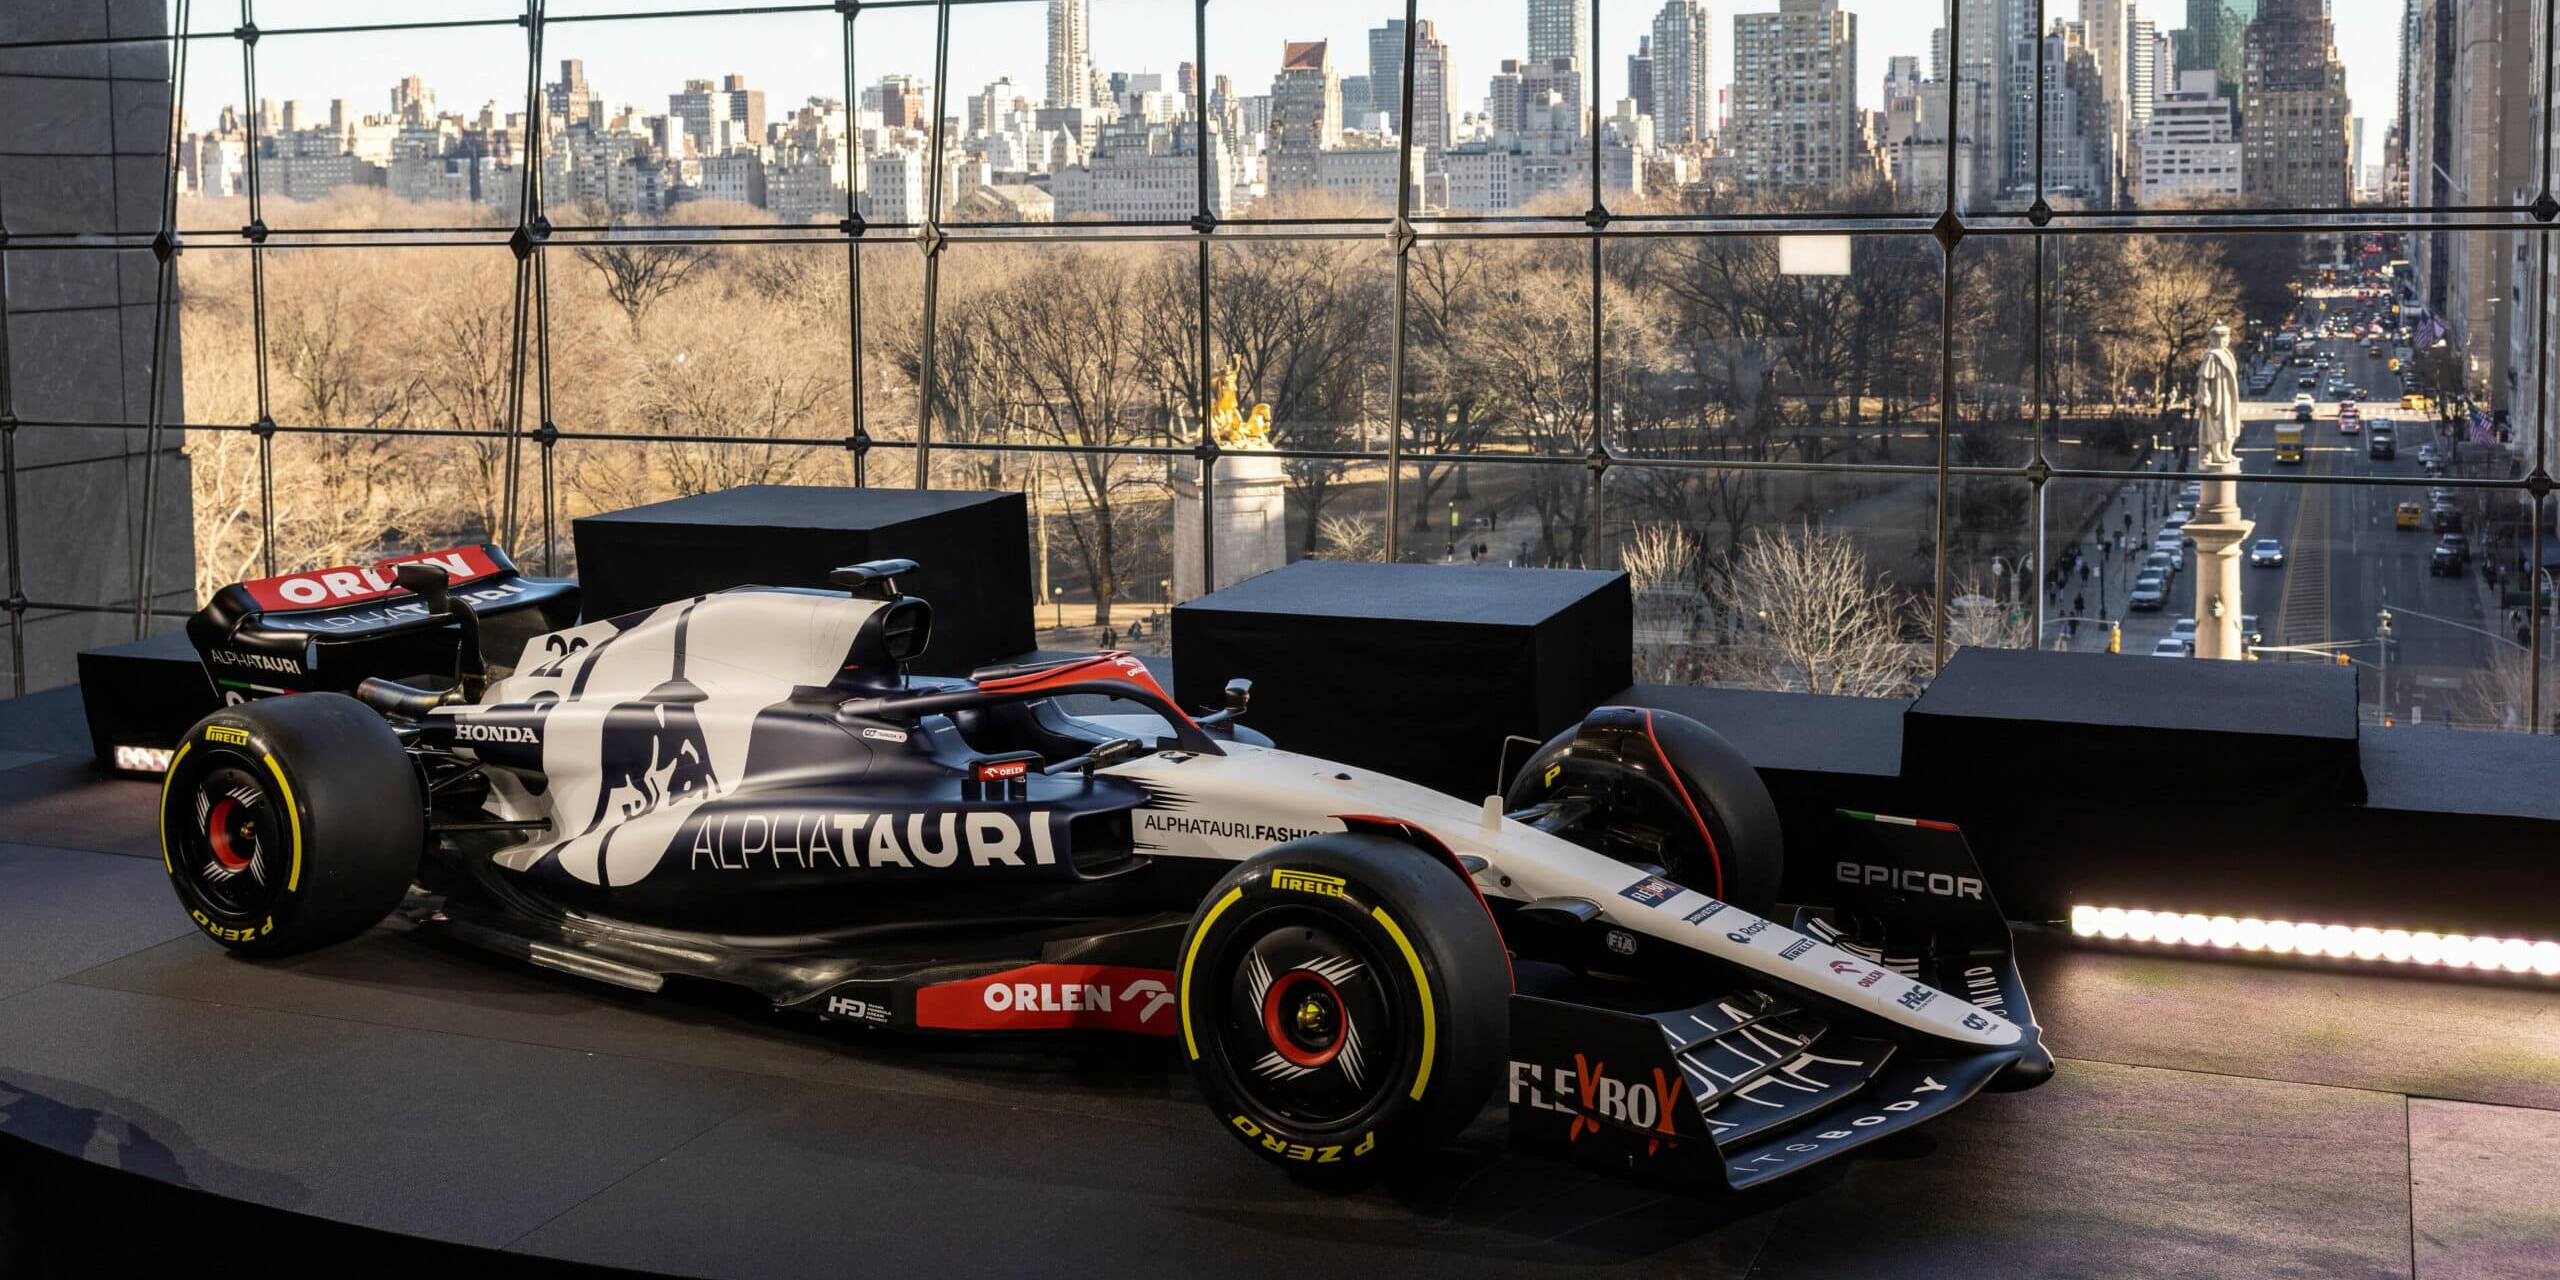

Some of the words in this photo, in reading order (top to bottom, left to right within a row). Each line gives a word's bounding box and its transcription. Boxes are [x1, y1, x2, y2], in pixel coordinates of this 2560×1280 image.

[279, 553, 476, 604] ORLN
[211, 648, 302, 676] ALPHATAURI
[205, 725, 248, 746] PIRELLI
[454, 723, 540, 744] HONDA
[999, 766, 1024, 776] ORLEN
[691, 810, 1057, 872] ALPHATAURI
[1271, 868, 1347, 898] PIRELLI
[983, 982, 1112, 1013] ORLEN
[1508, 1053, 1683, 1157] FLEXBOX
[1231, 1114, 1343, 1164] ZERO
